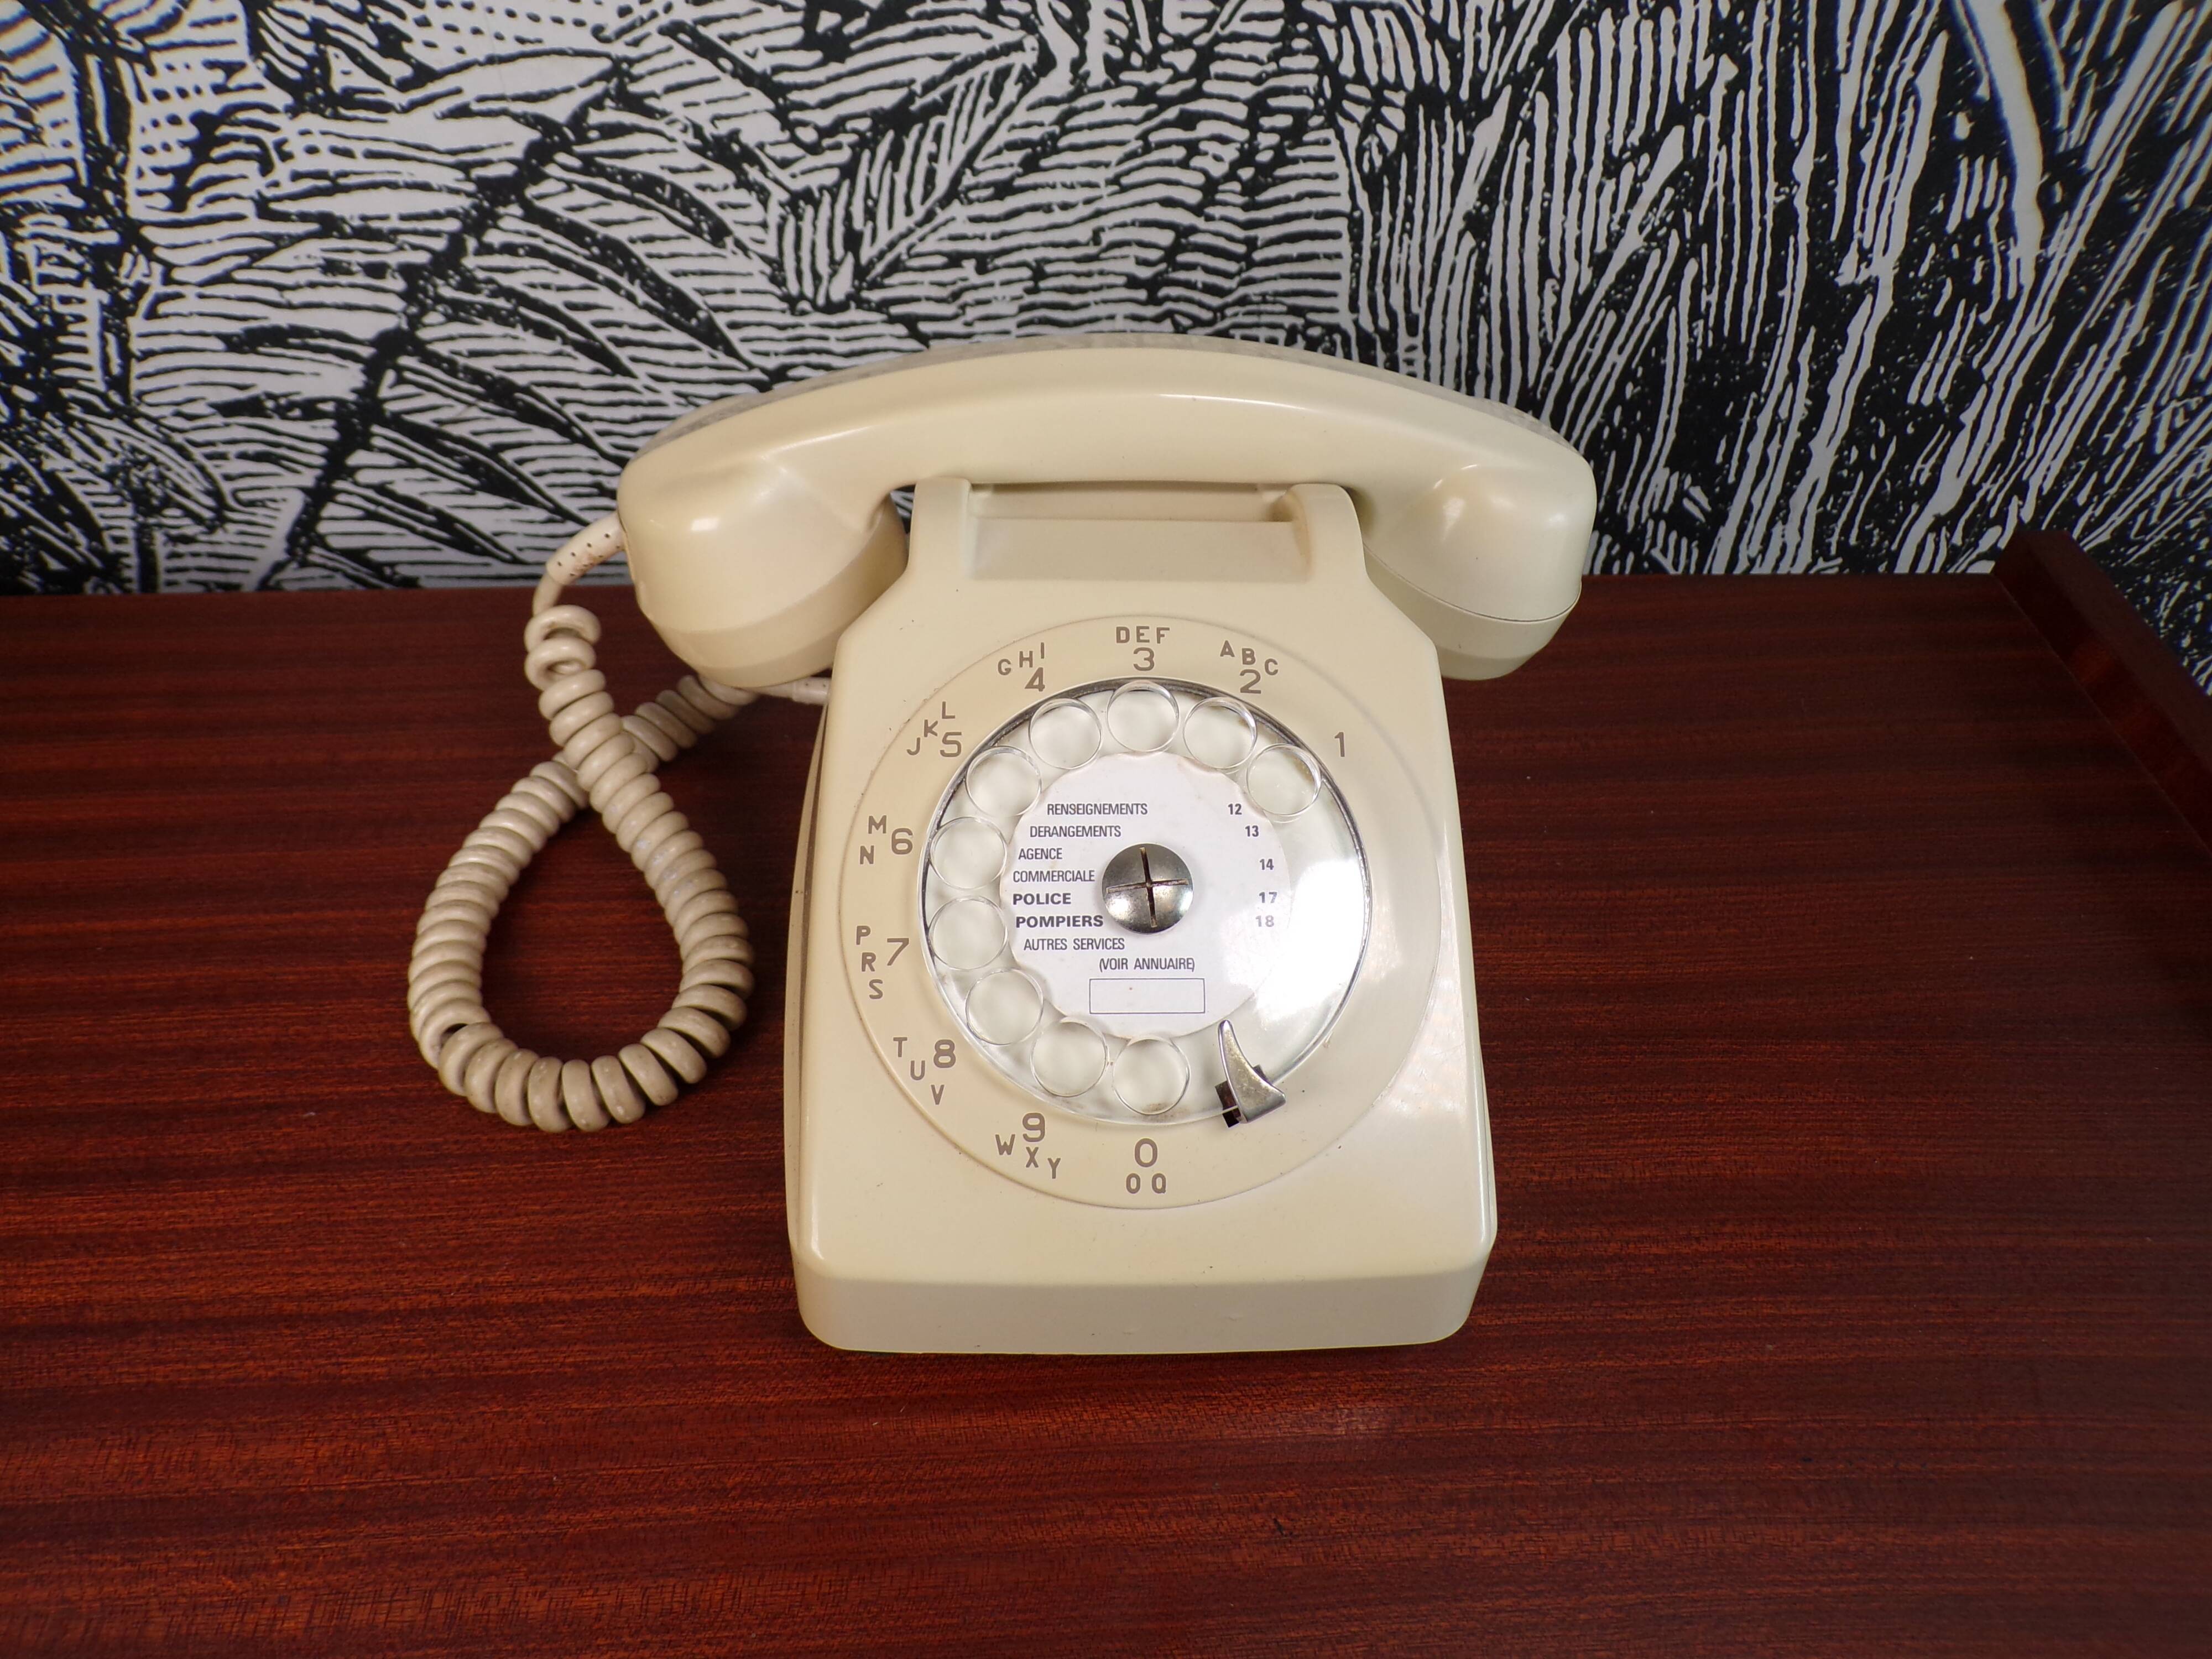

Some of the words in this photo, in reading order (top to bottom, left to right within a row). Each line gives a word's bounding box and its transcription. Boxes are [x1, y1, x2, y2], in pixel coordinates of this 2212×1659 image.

[1116, 625, 1170, 644] DEF
[1133, 647, 1155, 671] 3
[1024, 667, 1045, 692] 4
[1239, 669, 1261, 694] 2
[940, 732, 962, 758] 5
[1334, 732, 1345, 758] 1
[1047, 803, 1148, 815] RENSEIGNEMENTS
[1228, 804, 1242, 815] 12
[1030, 825, 1121, 838] DERANGEMENTS
[1245, 825, 1259, 837] 13
[891, 828, 913, 855] 6
[1018, 848, 1062, 860] AGENCE
[1260, 858, 1274, 870] 14
[1013, 870, 1095, 883] COMMERCIALE
[1013, 893, 1071, 905] POLICE
[1259, 891, 1277, 903] 17
[1016, 915, 1103, 928] POMPIERS
[1255, 915, 1275, 927] 18
[886, 937, 910, 966] 7
[1024, 938, 1067, 951] AUTRES
[1073, 937, 1125, 950] SERVICES
[1099, 958, 1128, 972] (VOIR
[1134, 957, 1195, 972] ANNUAIRE)
[933, 1039, 956, 1068] 8
[1022, 1112, 1045, 1142] 9
